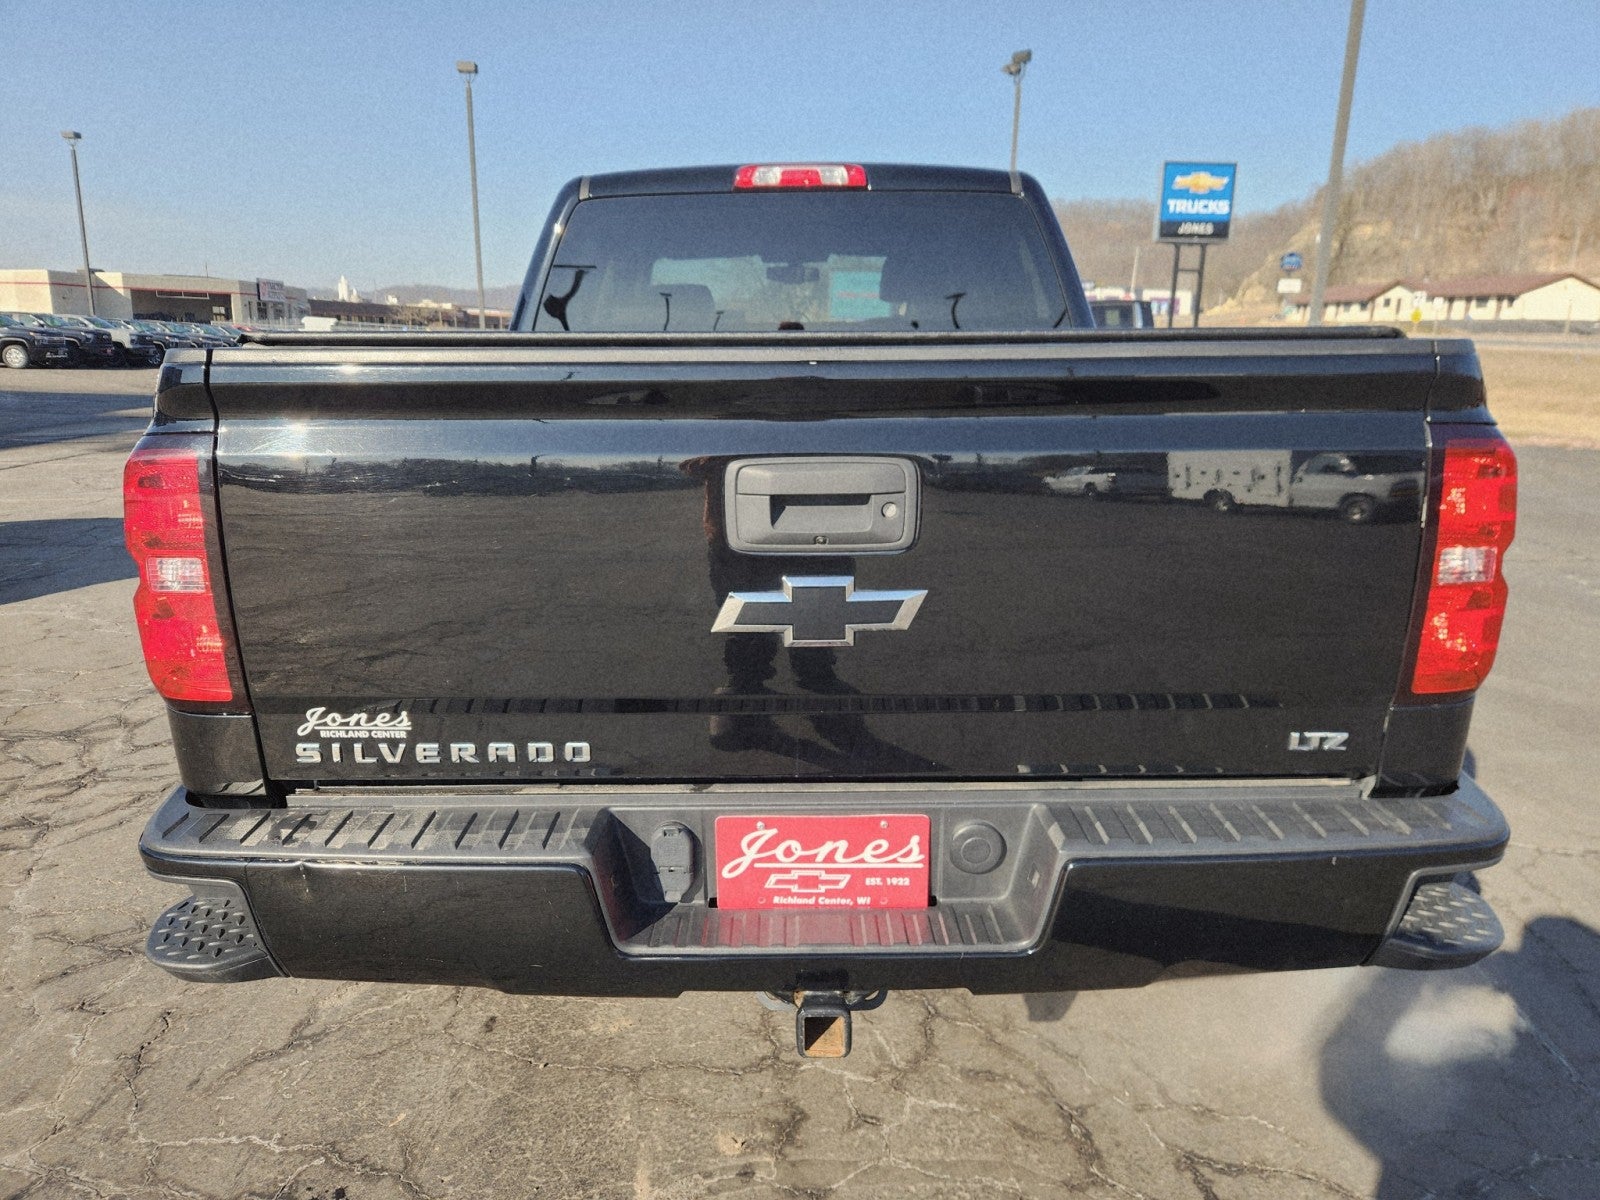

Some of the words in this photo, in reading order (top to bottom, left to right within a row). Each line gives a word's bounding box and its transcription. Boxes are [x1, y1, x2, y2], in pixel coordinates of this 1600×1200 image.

[1167, 198, 1230, 215] TRUCKS
[297, 706, 412, 736] Jones
[320, 730, 369, 738] RICHLAND
[371, 730, 406, 738] CENTER
[1288, 731, 1349, 751] LTZ
[295, 742, 591, 764] SILVERADO
[721, 828, 925, 878] Jones
[864, 877, 883, 886] EST.
[886, 877, 910, 886] 1922
[773, 895, 816, 905] Richland
[818, 896, 853, 906] Center,
[857, 896, 871, 905] WI
